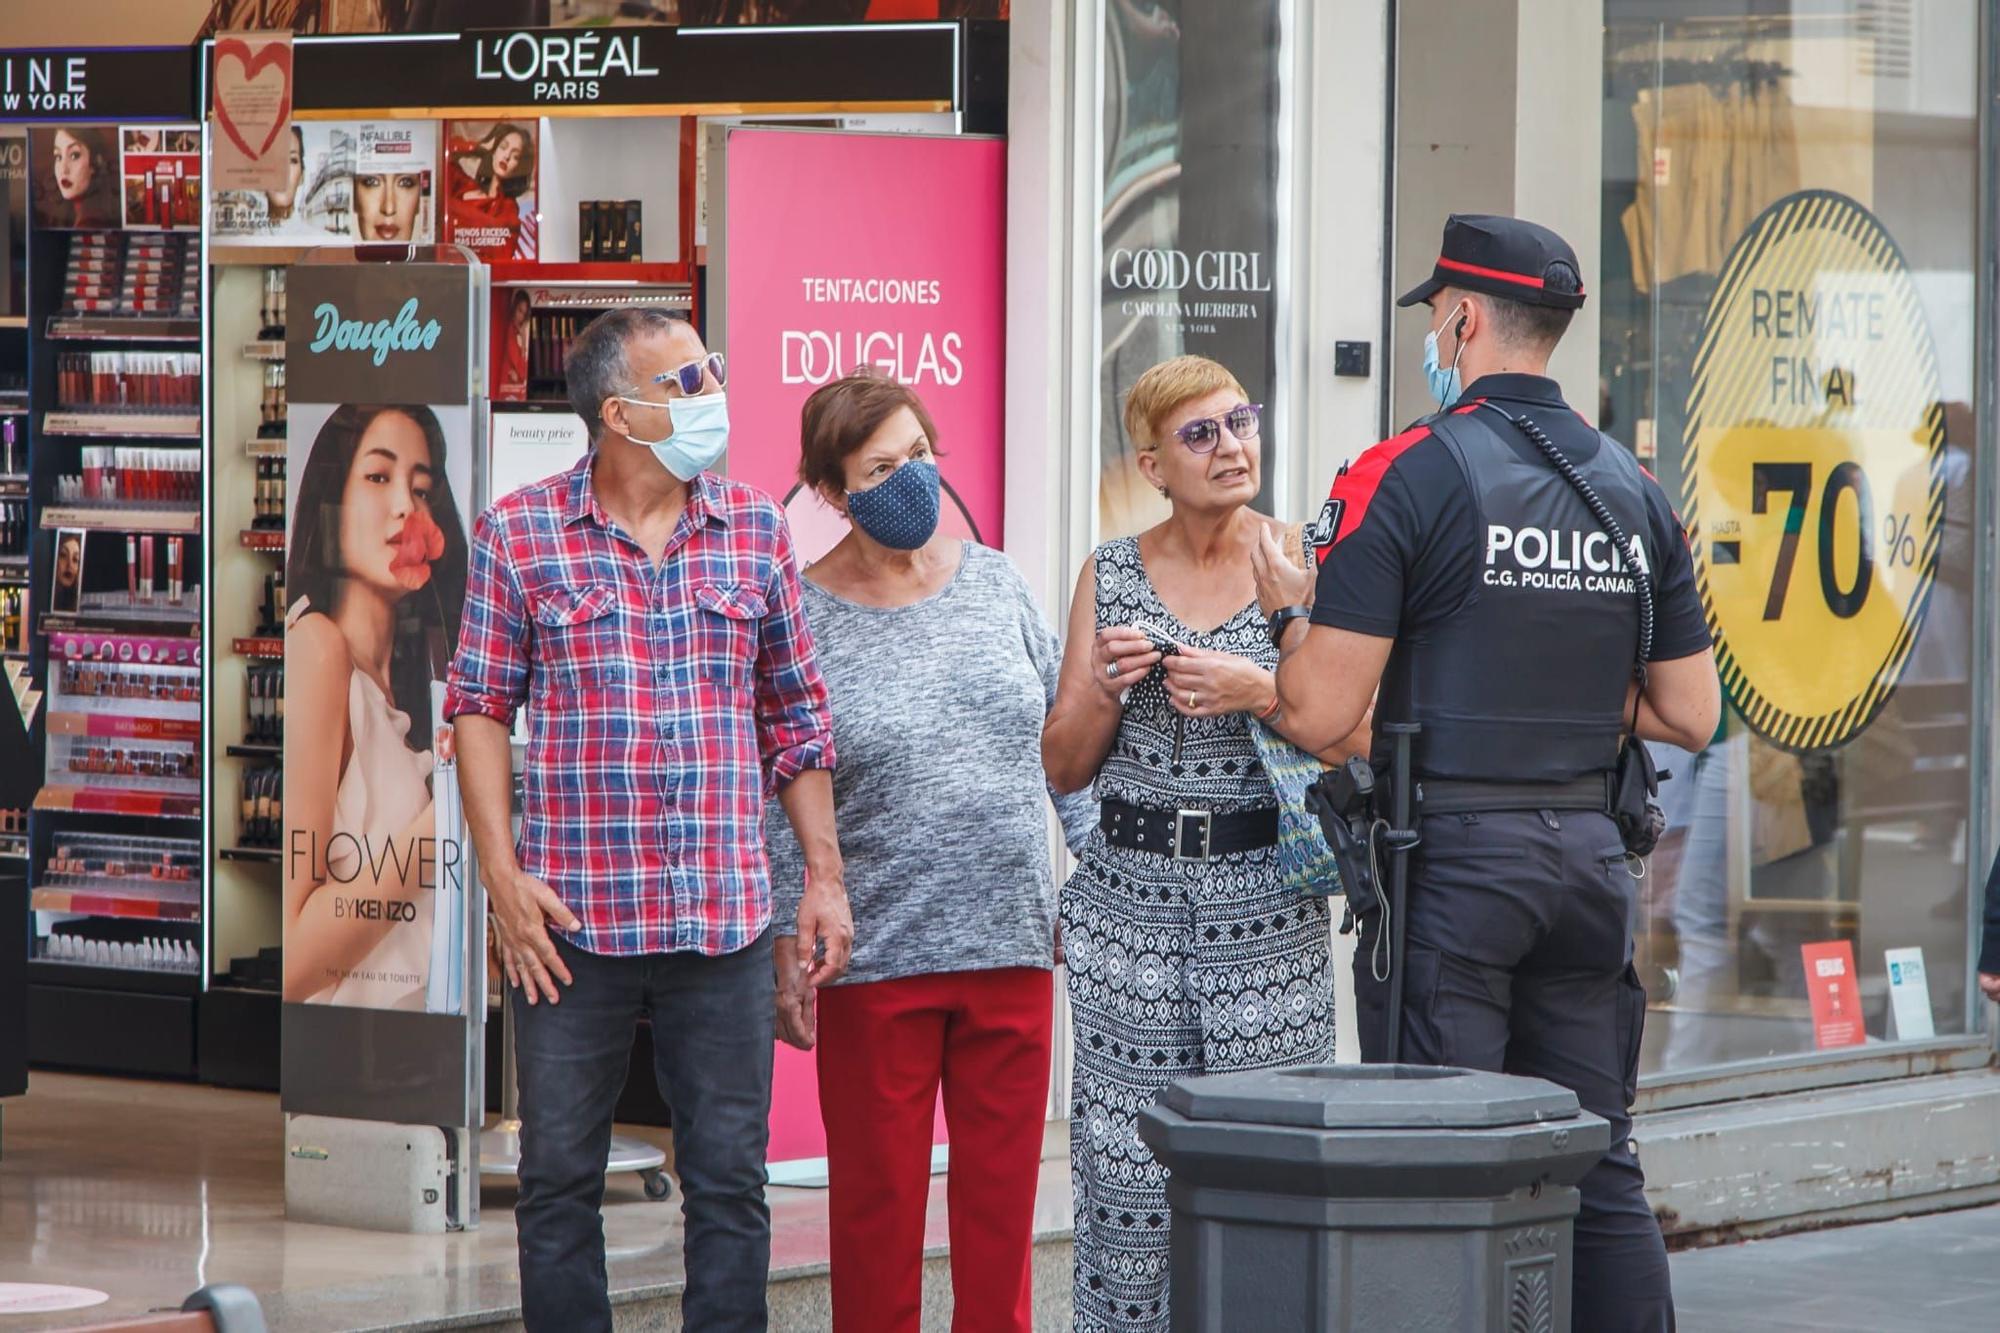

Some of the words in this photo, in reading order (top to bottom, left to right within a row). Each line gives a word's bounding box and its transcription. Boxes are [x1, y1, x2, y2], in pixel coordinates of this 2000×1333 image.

[476, 31, 659, 81] L'ORÉAL
[28, 93, 86, 111] YORK
[1109, 248, 1190, 290] GOOD
[1195, 250, 1271, 292] GIRL
[802, 278, 941, 304] TENTACIONES
[1121, 301, 1190, 318] CAROLINA
[1194, 302, 1257, 319] HERRERA
[1751, 289, 1885, 340] REMATE
[310, 297, 441, 366] Douglas
[1190, 324, 1216, 334] YORK
[781, 330, 963, 386] DOUGLAS
[1770, 356, 1860, 406] FINAL
[510, 426, 546, 441] beauty
[547, 427, 575, 441] price
[1711, 520, 1742, 535] HASTA
[1483, 569, 1517, 587] C.G.
[1521, 571, 1582, 592] POLICÍA
[290, 829, 461, 891] FLOWER
